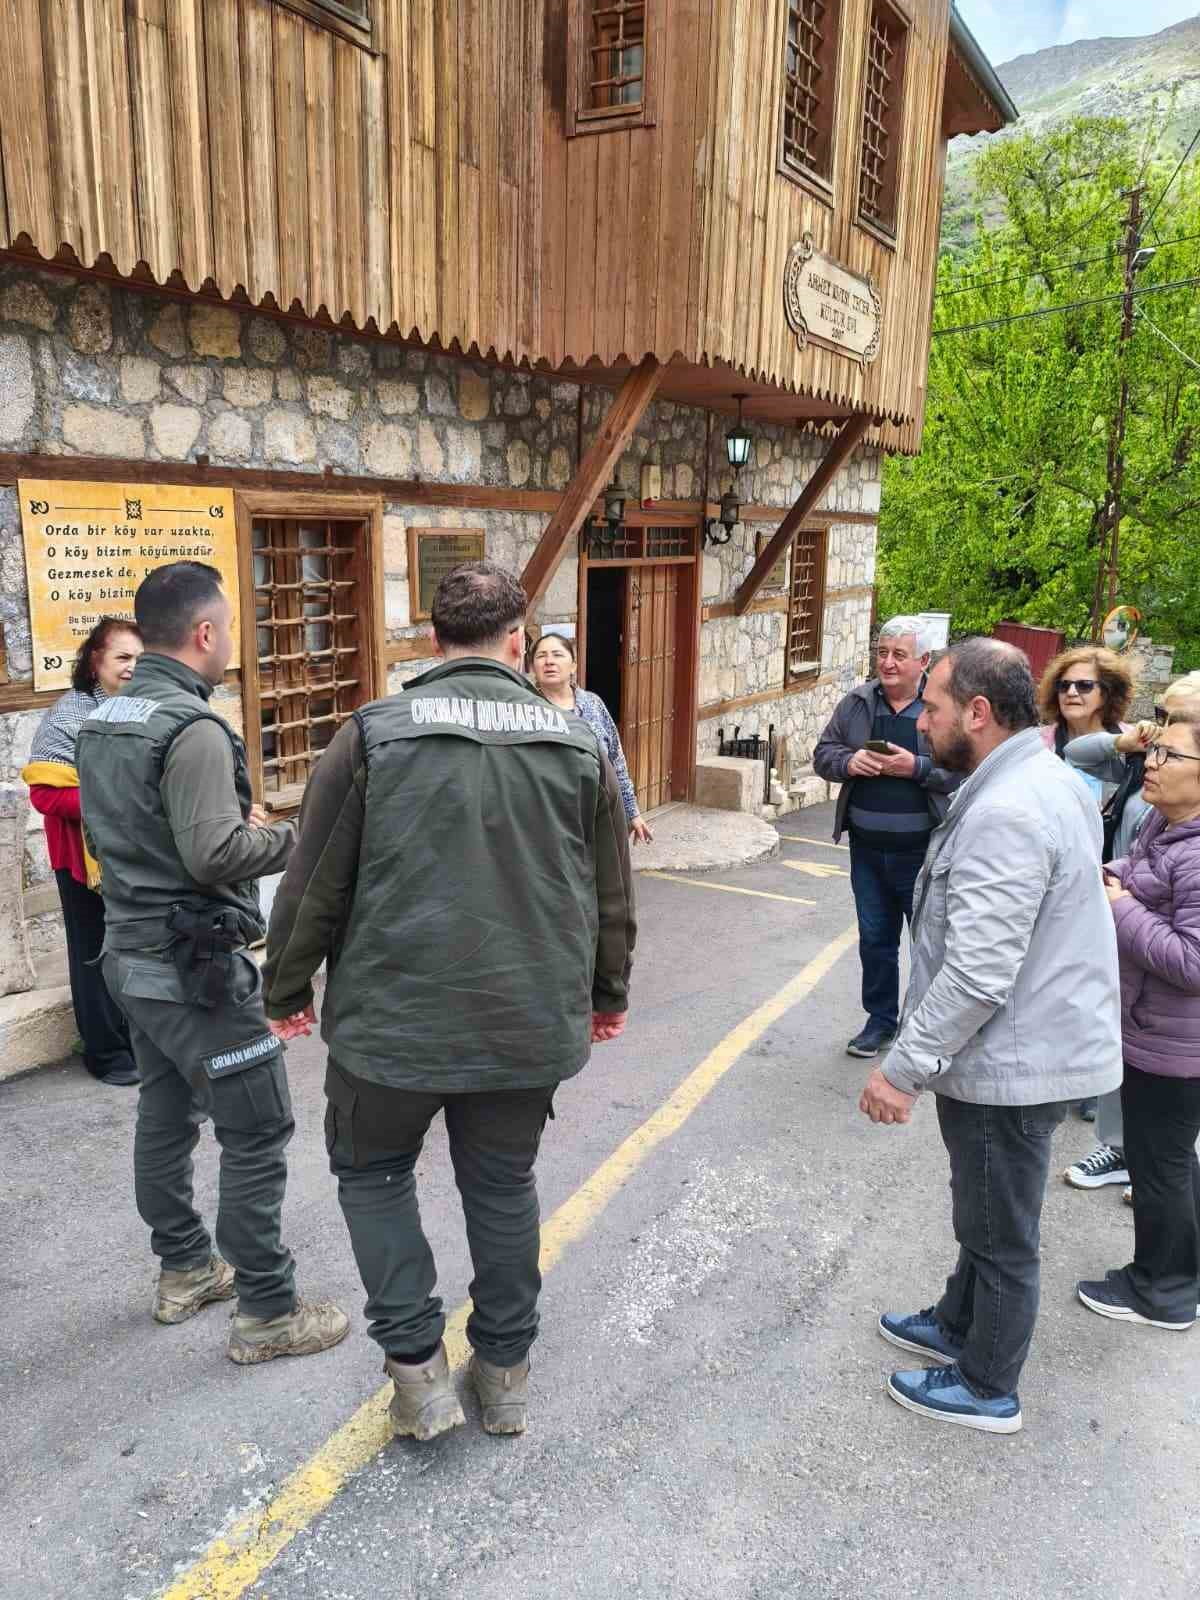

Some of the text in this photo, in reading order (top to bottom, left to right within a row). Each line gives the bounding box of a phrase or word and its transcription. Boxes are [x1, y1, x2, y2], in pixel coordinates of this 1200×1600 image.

[46, 524, 79, 536] Orda
[87, 524, 107, 536] bir
[114, 525, 137, 538] köy
[144, 527, 163, 536] var
[47, 546, 56, 558] O
[65, 546, 88, 560] köy
[97, 546, 132, 557] bizim
[48, 567, 113, 580] Gezmesek
[51, 588, 135, 602] O köy bizim
[411, 697, 571, 735] ORMAN MUHAFAZA
[212, 1034, 281, 1070] ORMAN MUHAFAZA
